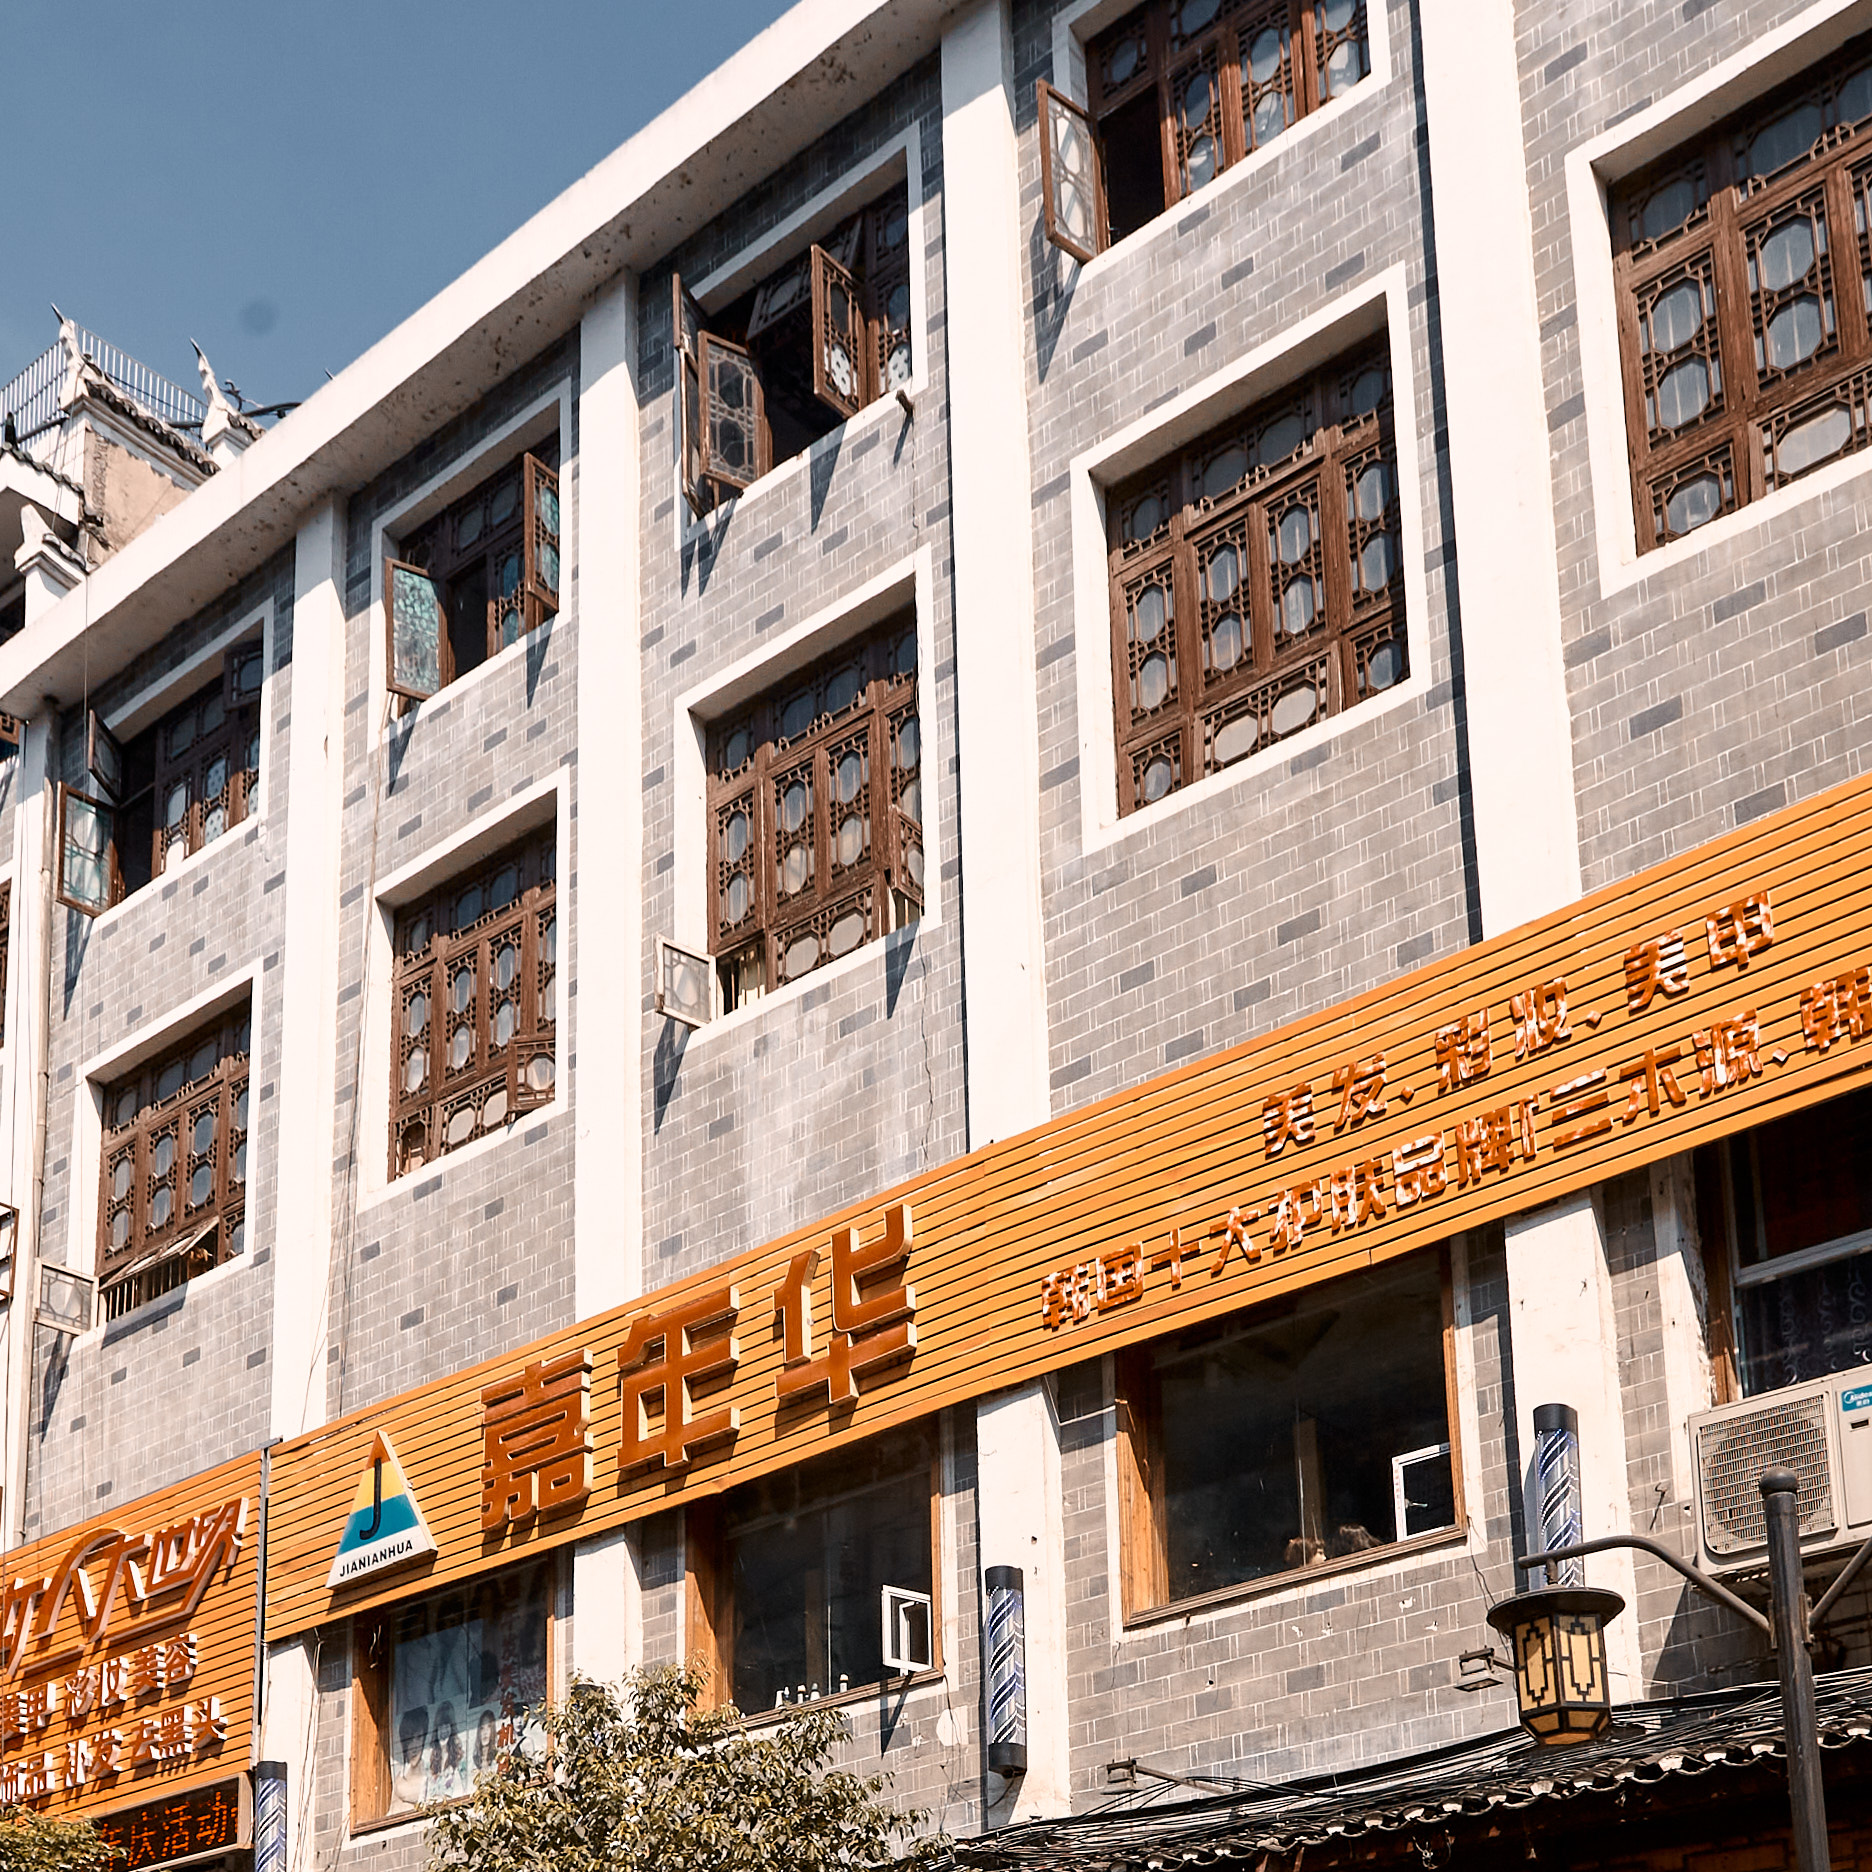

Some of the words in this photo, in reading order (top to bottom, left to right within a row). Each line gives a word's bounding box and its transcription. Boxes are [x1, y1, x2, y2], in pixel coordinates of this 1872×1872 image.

[480, 1203, 917, 1535] 嘉年华
[338, 1538, 415, 1578] JIANIANHUA
